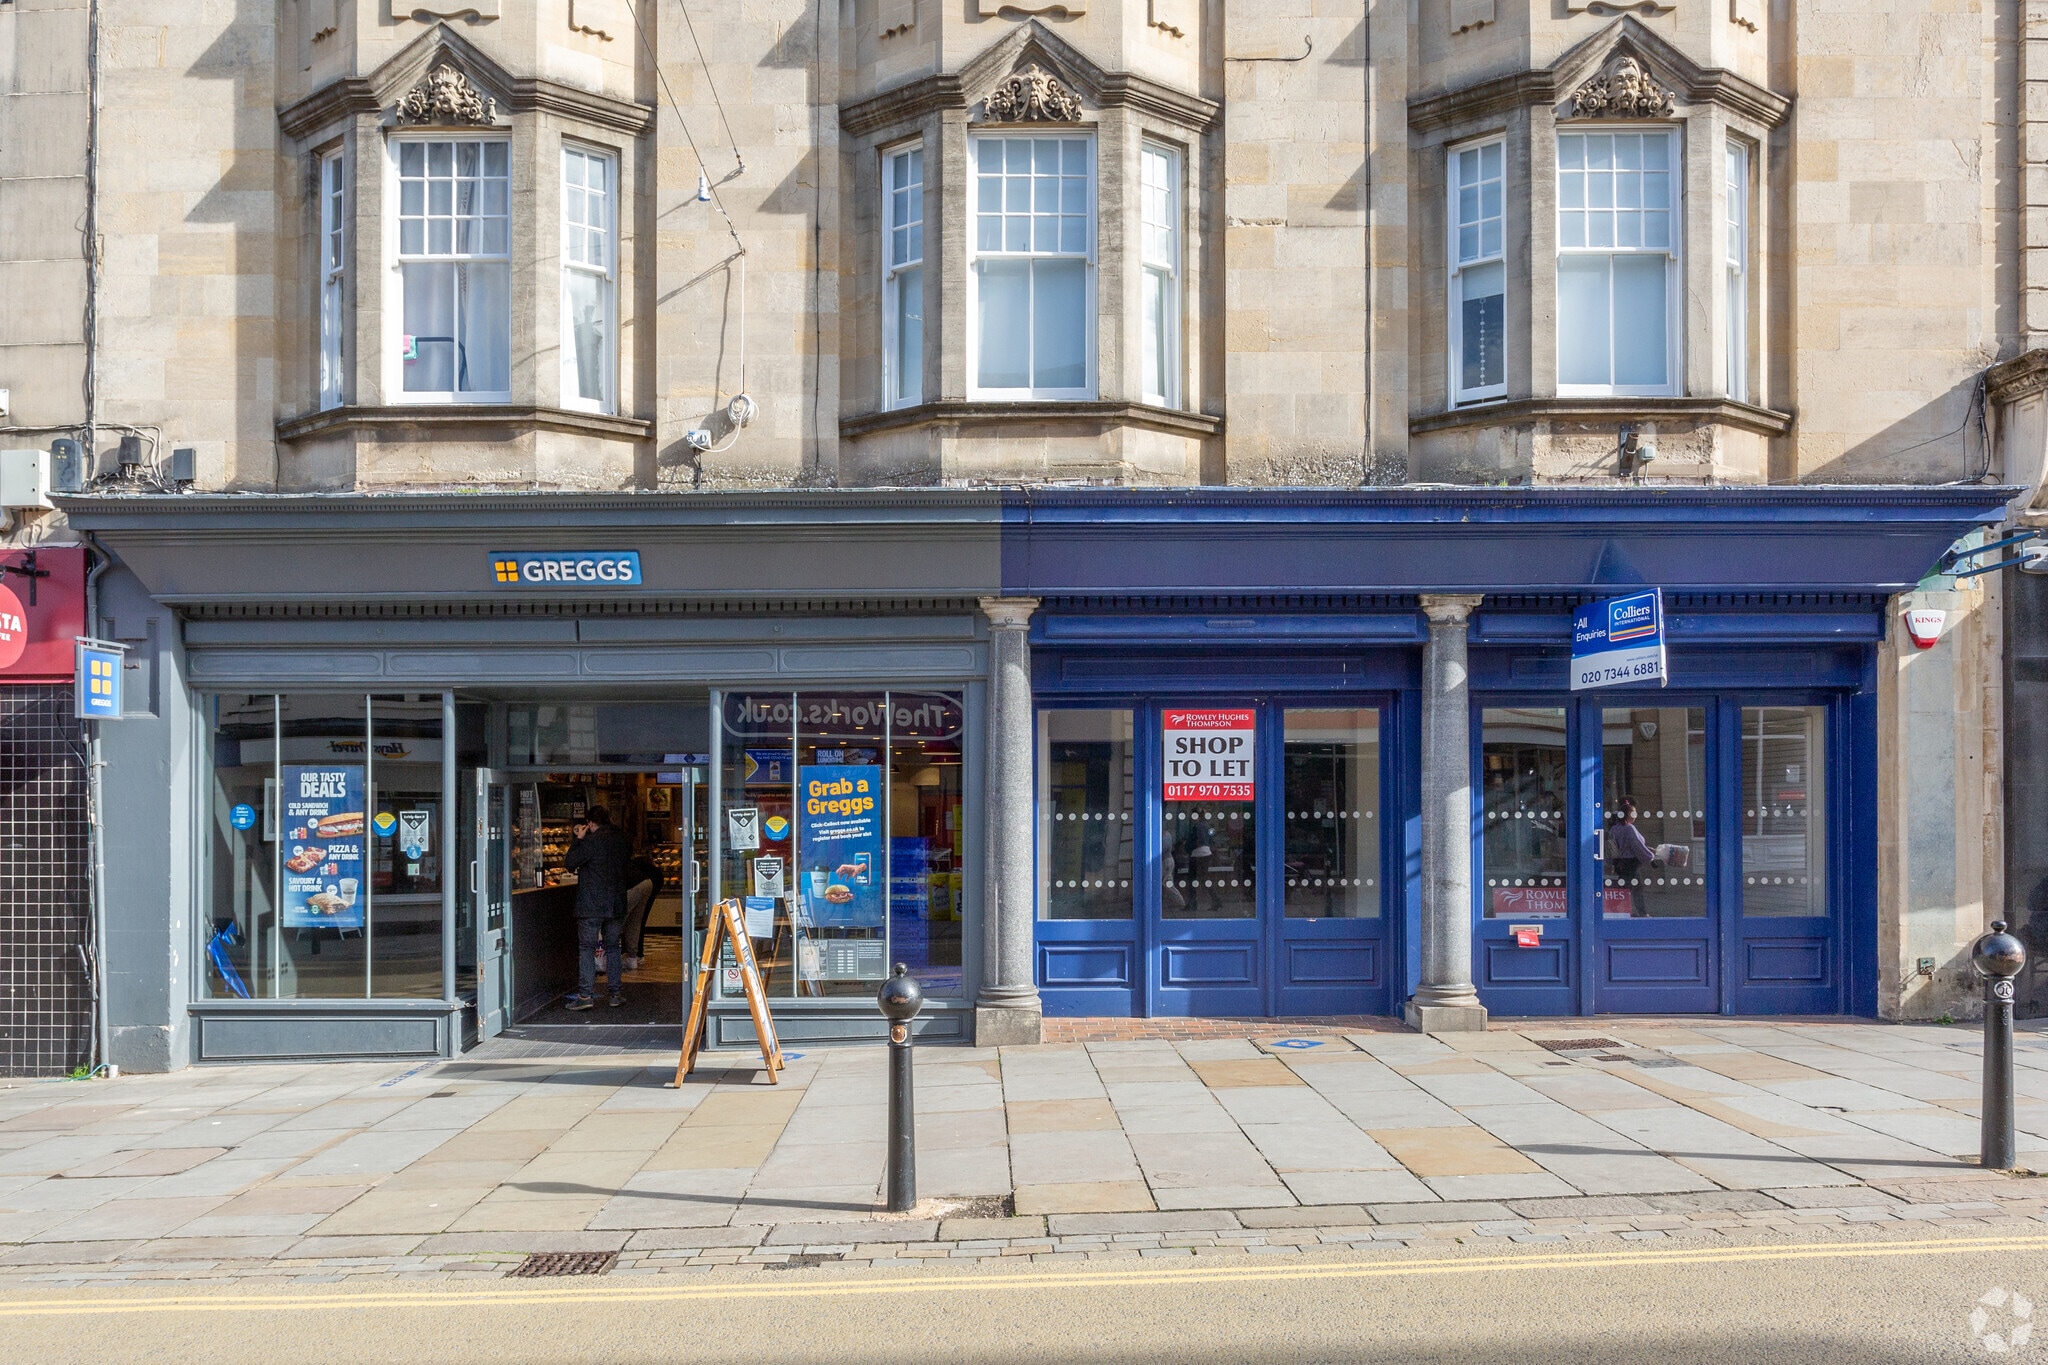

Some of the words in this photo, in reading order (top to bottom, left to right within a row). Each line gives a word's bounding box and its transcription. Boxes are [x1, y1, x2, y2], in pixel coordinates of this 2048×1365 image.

[523, 560, 633, 582] GREGGS
[1613, 605, 1650, 621] Colliers
[0, 611, 22, 633] TA
[1576, 617, 1588, 630] All
[1614, 615, 1650, 627] INTERNATIONAL
[1576, 629, 1607, 643] Enquiries
[1581, 670, 1602, 684] 020
[1604, 665, 1630, 681] 7344
[1633, 660, 1659, 676] 6881
[1218, 713, 1249, 721] HUGHES
[1175, 737, 1244, 754] SHOP
[817, 750, 833, 758] ROLL
[1169, 760, 1202, 777] TO
[1210, 760, 1250, 777] LET
[301, 773, 318, 782] OUR
[320, 772, 346, 783] TASTY
[300, 782, 346, 798] DEALS
[808, 777, 853, 797] Grab
[856, 779, 869, 793] a
[1168, 785, 1196, 796] 0117
[1199, 785, 1220, 796] 970
[1223, 785, 1251, 796] 7535
[807, 796, 874, 817] Greggs
[850, 817, 871, 825] available
[812, 834, 831, 842] register
[328, 844, 350, 854] PIZZA
[351, 844, 359, 853] &
[288, 877, 315, 885] SAVOURY
[316, 877, 322, 885] &
[1526, 889, 1567, 900] ROWLE
[1603, 889, 1625, 900] HES
[1526, 900, 1566, 910] THOM
